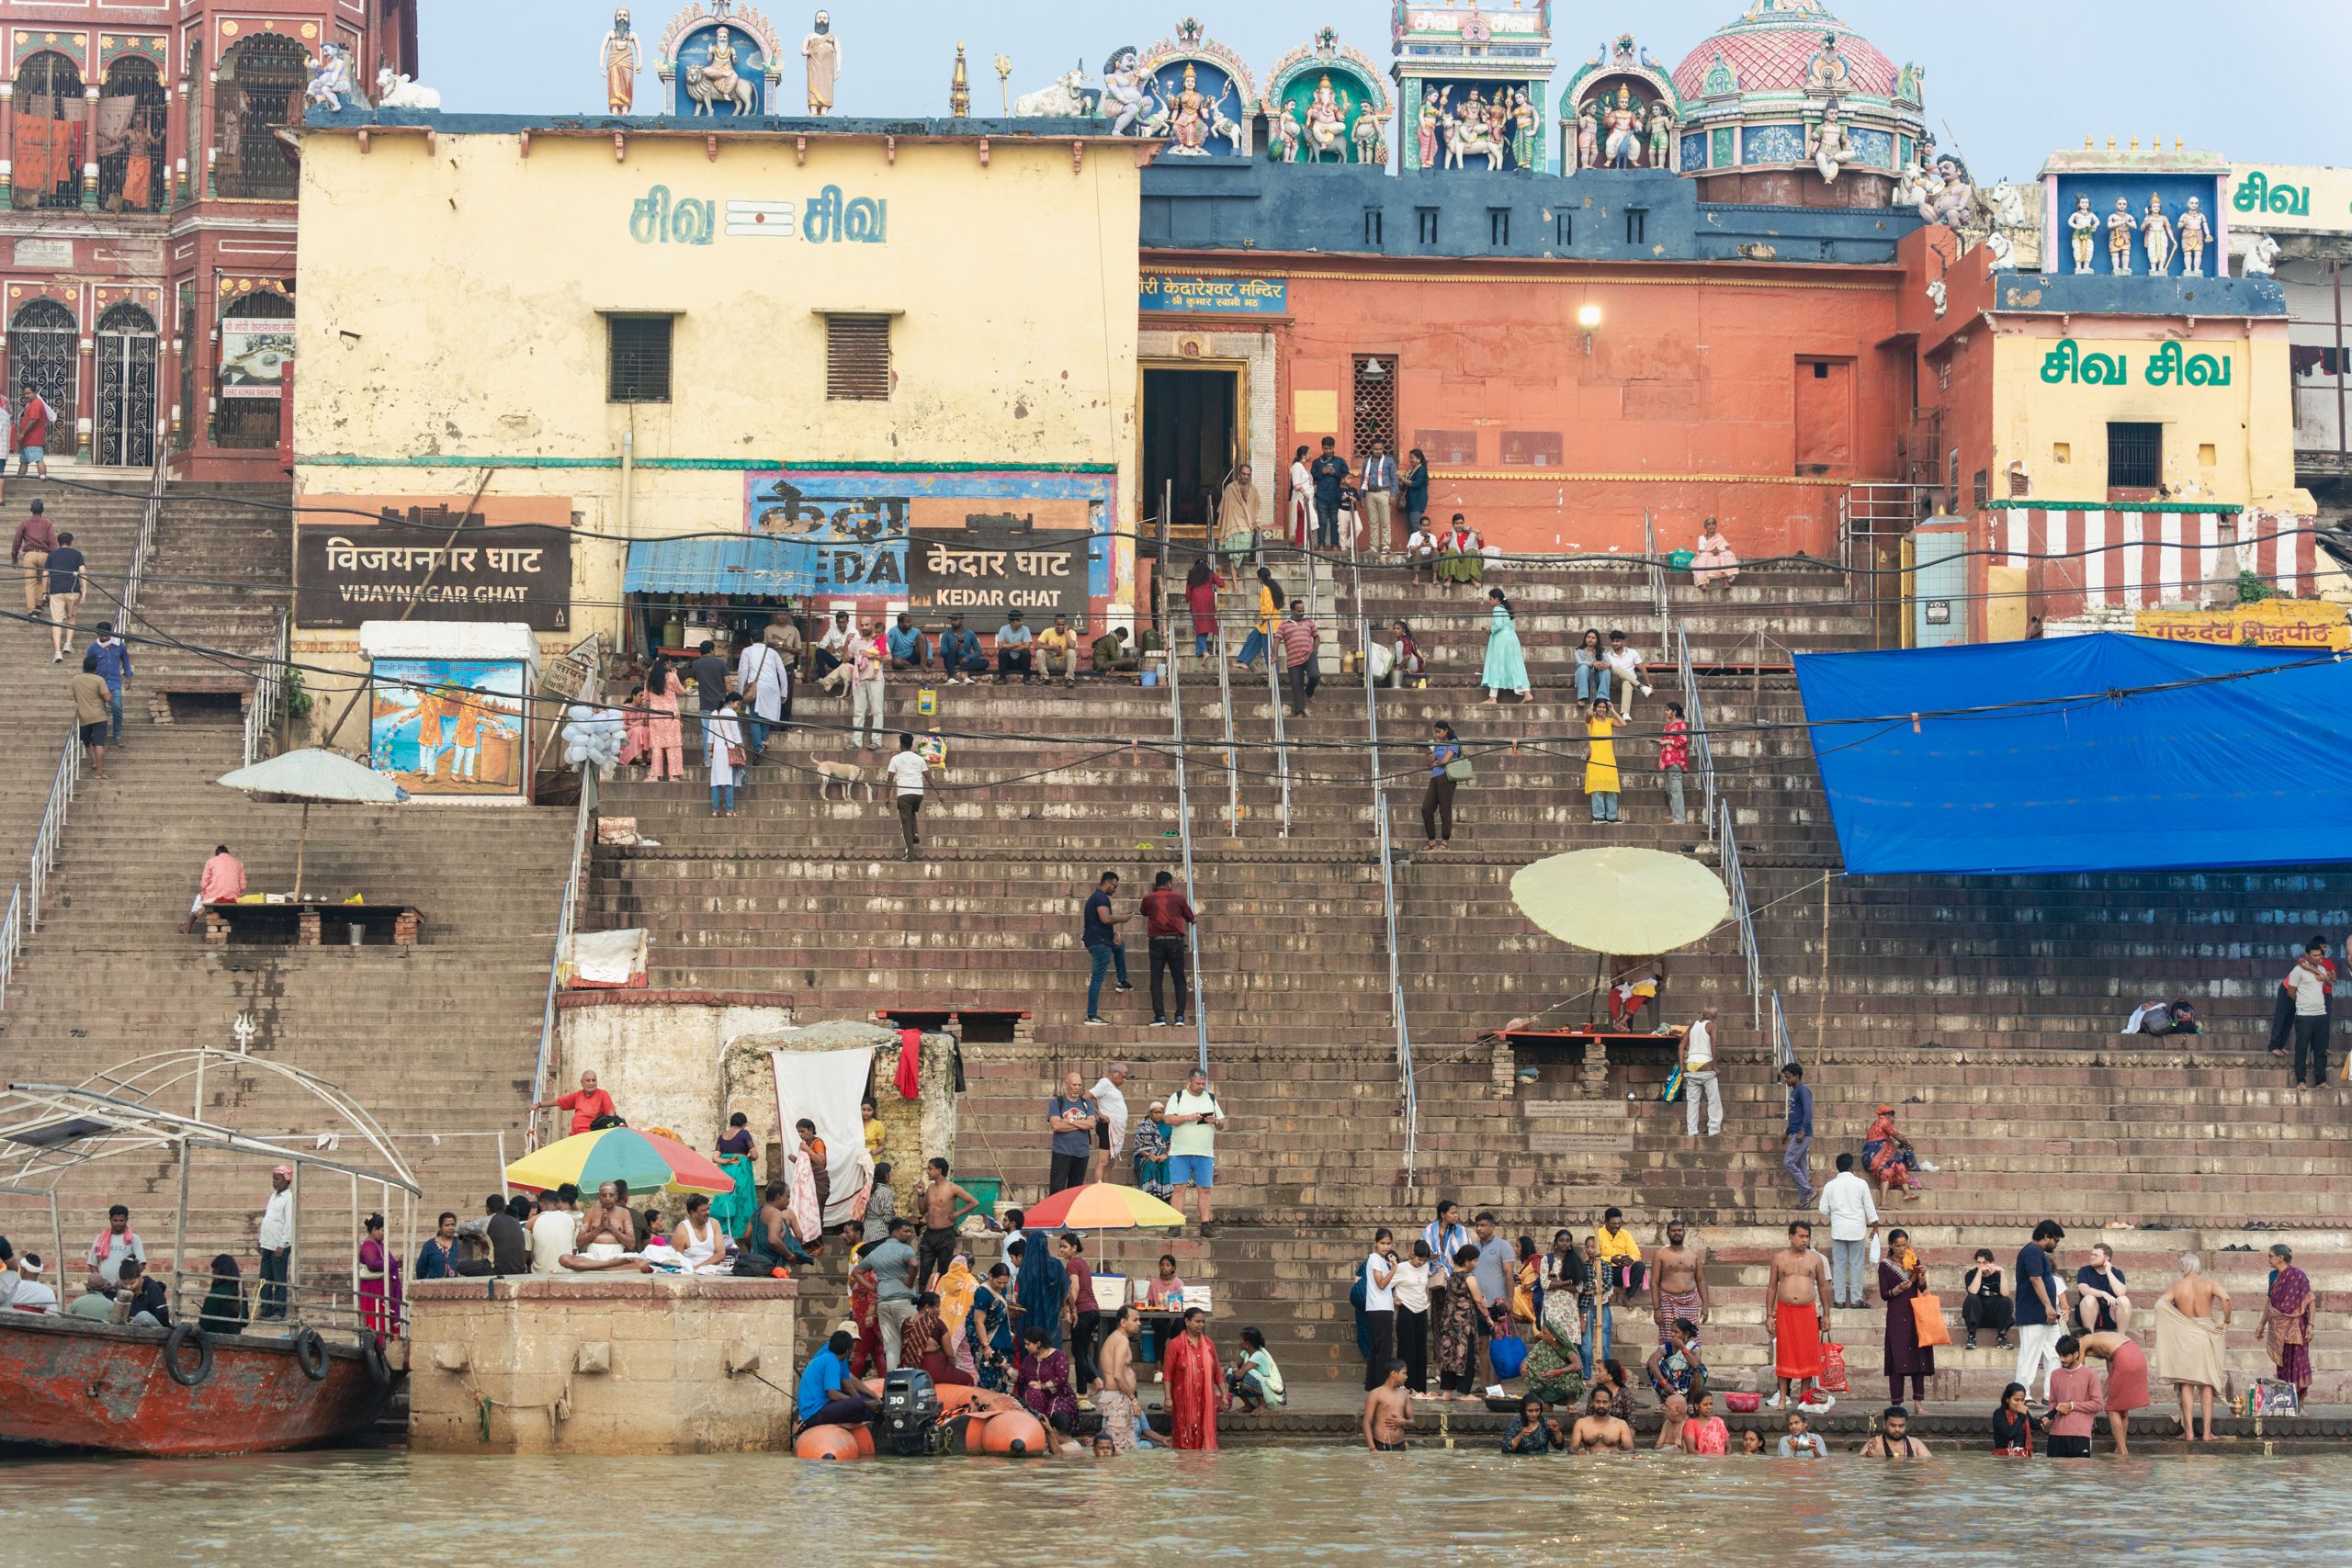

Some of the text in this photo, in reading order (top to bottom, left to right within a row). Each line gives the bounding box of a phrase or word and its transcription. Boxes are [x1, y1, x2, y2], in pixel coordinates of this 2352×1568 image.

[2233, 171, 2310, 216] சிவ
[629, 184, 888, 245] சிவ சிவ
[1162, 276, 1235, 297] केदारेश्वर
[1238, 279, 1284, 299] मन्दिर
[2041, 338, 2231, 386] சிவ சிவ
[757, 479, 910, 545] केदा
[326, 536, 543, 572] विजयनगर घाट
[926, 543, 1071, 578] केदार घाट
[339, 584, 528, 604] VIJAYNAGAR GHAT
[936, 589, 1061, 606] KEDAR GHAT
[889, 1396, 905, 1404] 30
